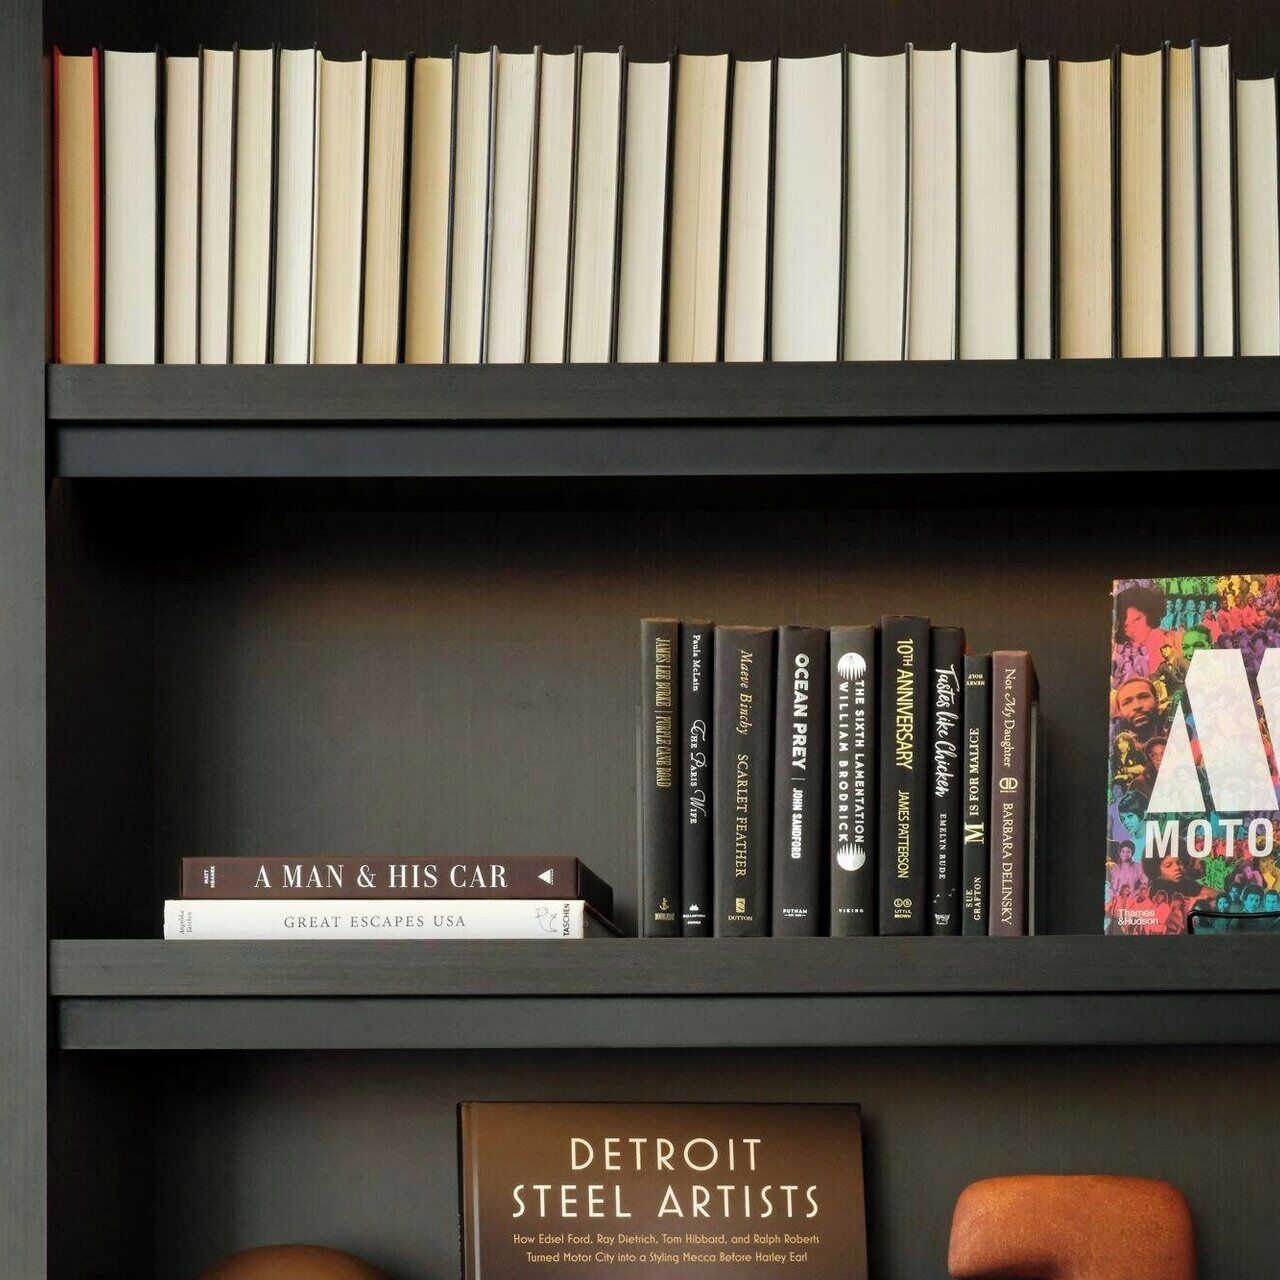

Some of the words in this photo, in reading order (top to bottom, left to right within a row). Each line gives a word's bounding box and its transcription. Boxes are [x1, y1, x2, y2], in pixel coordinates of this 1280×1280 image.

[656, 637, 671, 663] JAMES
[693, 634, 701, 657] Paula
[897, 638, 914, 667] 10TH
[656, 665, 671, 681] LEE
[692, 660, 701, 692] McLain
[738, 648, 753, 689] Maeve
[793, 653, 810, 717] OCEAN
[1004, 668, 1016, 690] Not
[656, 681, 671, 707] BURKE
[855, 679, 865, 705] THE
[935, 664, 960, 708] Tastes
[736, 693, 753, 736] Binchy
[839, 681, 849, 752] WILLIAM
[895, 668, 914, 770] ANNIVERSARY
[1001, 692, 1016, 718] My
[656, 716, 671, 745] PURPLE
[855, 709, 865, 748] SIXTH
[935, 710, 959, 739] like
[791, 723, 808, 770] PREY
[969, 728, 980, 774] MALICE
[1000, 719, 1016, 768] Daughter
[656, 767, 672, 787] ROAD
[737, 754, 749, 813] SCARLET
[934, 740, 958, 798] Chicken
[792, 787, 803, 811] JOHN
[838, 760, 849, 842] BRODRICK
[854, 753, 865, 843] LAMENTATION
[897, 790, 910, 822] JAMES
[969, 777, 980, 802] FOR
[969, 804, 979, 816] IS
[735, 817, 748, 878] FEATHER
[790, 813, 803, 859] SANDFORD
[939, 813, 947, 850] EMELYN
[964, 821, 985, 845] M
[1002, 803, 1014, 859] BARBARA
[897, 823, 910, 878] PATTERSON
[254, 864, 272, 888] A
[282, 864, 344, 888] MAN
[357, 865, 377, 888] &
[388, 864, 438, 888] HIS
[449, 864, 509, 888] CAR
[965, 889, 973, 908] SUE
[973, 877, 982, 921] GRAFTON
[1001, 862, 1013, 925] DELINSKY
[283, 915, 342, 929] GREAT
[350, 914, 425, 928] ESCAPES
[433, 915, 467, 928] USA
[563, 903, 571, 937] TASCHEN
[570, 1137, 762, 1172] DETROIT
[511, 1184, 632, 1218] STEEL
[657, 1184, 820, 1218] ARTISTS
[513, 1233, 535, 1244] How
[538, 1233, 564, 1244] Edsel
[597, 1233, 615, 1246] Ray
[618, 1233, 659, 1245] Dietrich,
[661, 1233, 682, 1244] Tom
[731, 1233, 750, 1244] and
[753, 1233, 781, 1246] Ralph
[784, 1233, 820, 1244] Roberts
[526, 1252, 560, 1263] Turned
[563, 1252, 592, 1263] Motor
[595, 1252, 615, 1264] City
[617, 1252, 636, 1263] into
[639, 1255, 647, 1263] a
[649, 1252, 680, 1264] Styling
[682, 1252, 716, 1263] Mecca
[719, 1252, 752, 1263] Before
[755, 1252, 787, 1264] Harley
[789, 1252, 808, 1262] Earl
